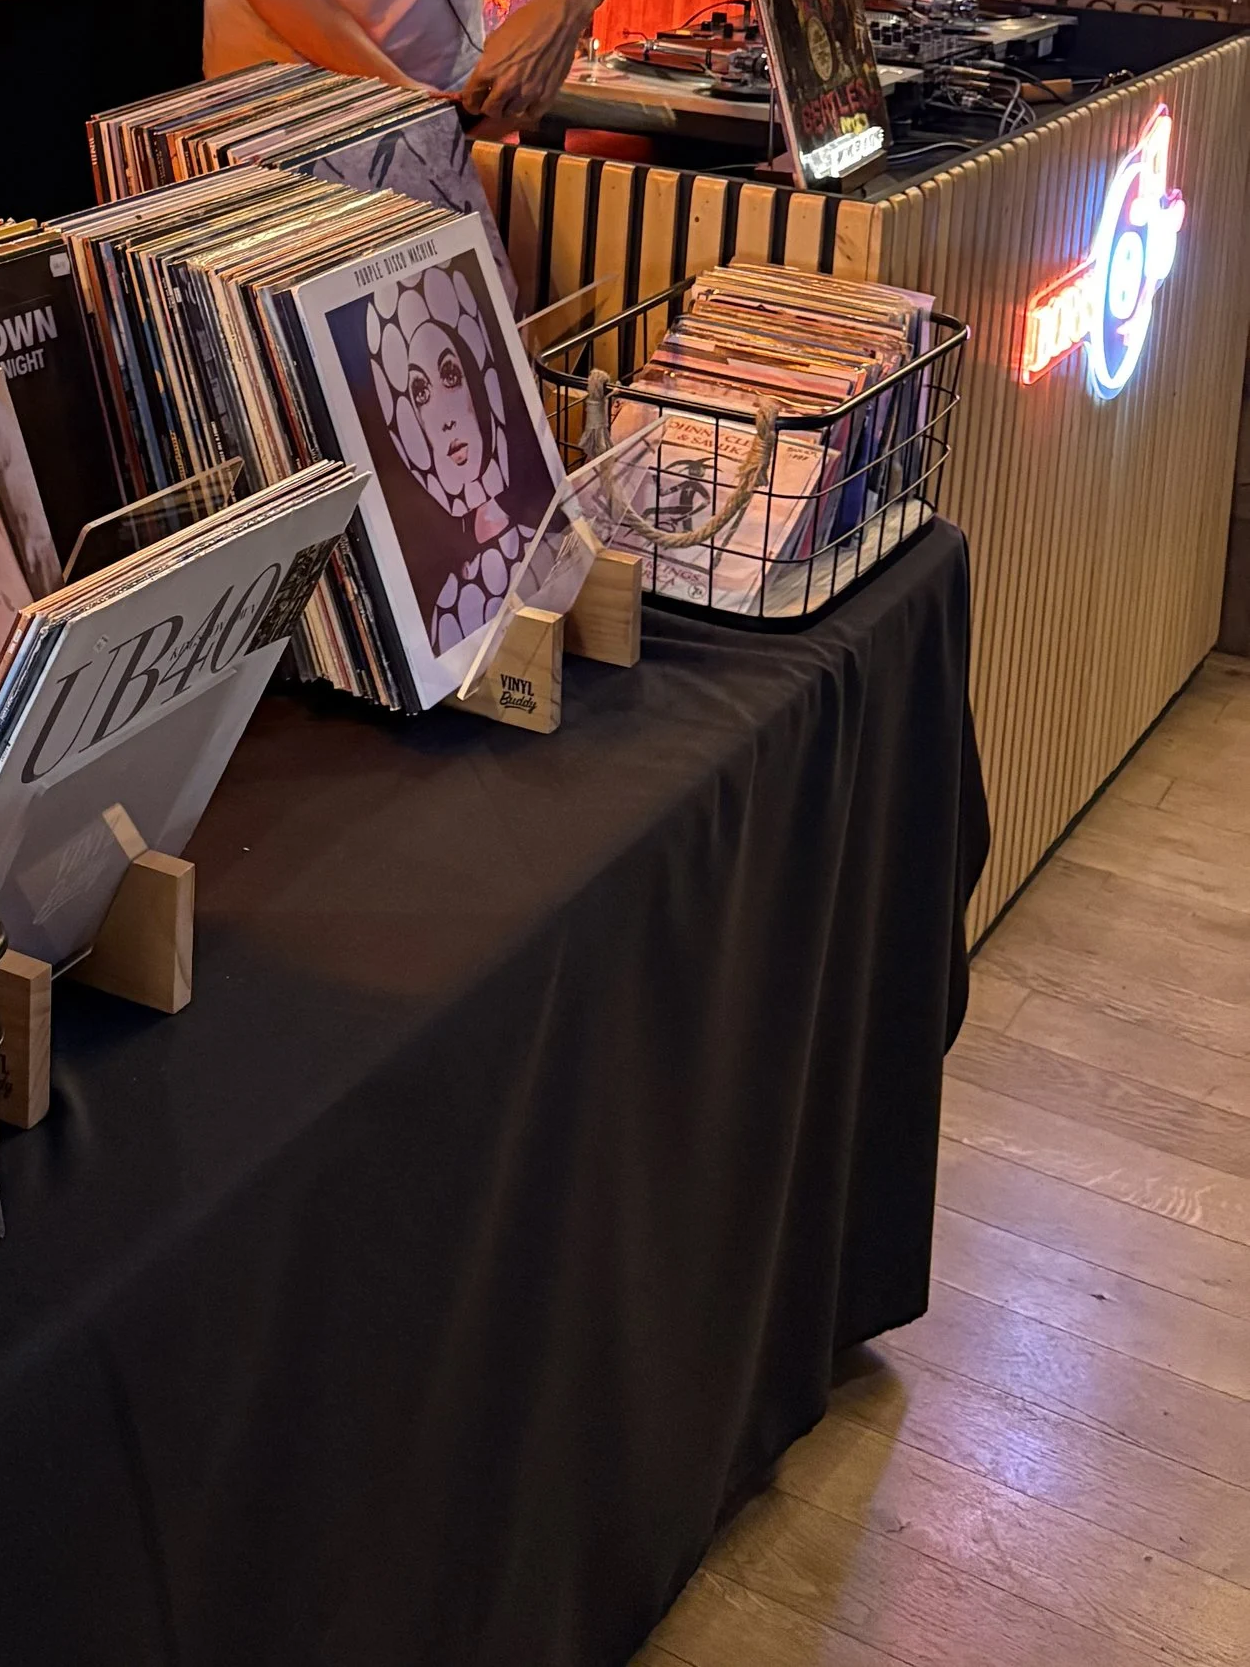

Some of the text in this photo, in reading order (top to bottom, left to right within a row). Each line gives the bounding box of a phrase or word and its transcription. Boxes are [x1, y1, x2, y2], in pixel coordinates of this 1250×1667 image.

[354, 239, 438, 287] PURPLE DISCO MACHINE
[2, 348, 46, 380] NIGHT
[20, 562, 282, 784] UB40
[500, 673, 534, 697] VINYL
[499, 690, 537, 714] Buddy
